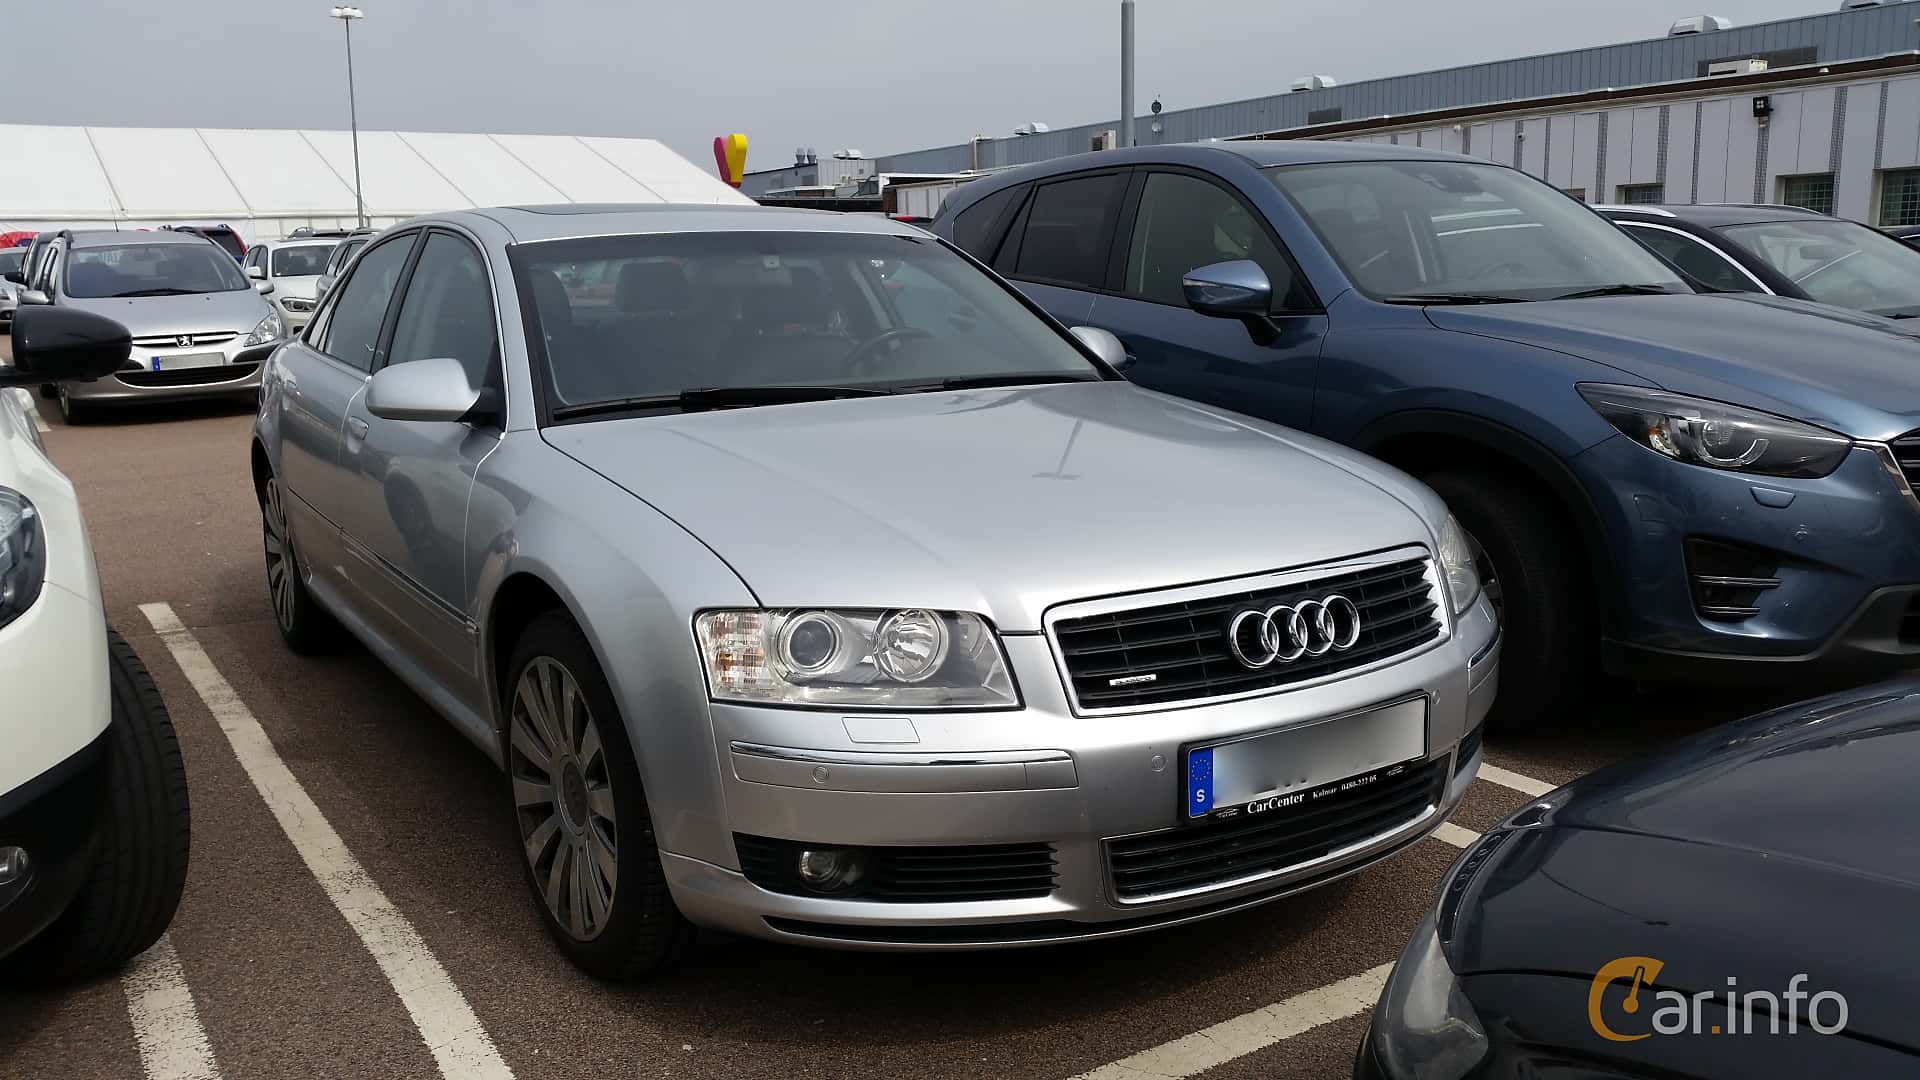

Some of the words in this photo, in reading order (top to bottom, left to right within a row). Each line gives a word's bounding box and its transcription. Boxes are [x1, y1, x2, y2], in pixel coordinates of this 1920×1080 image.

[1196, 789, 1205, 803] S
[1247, 793, 1305, 814] CarCenter
[1312, 787, 1338, 799] Kalmar
